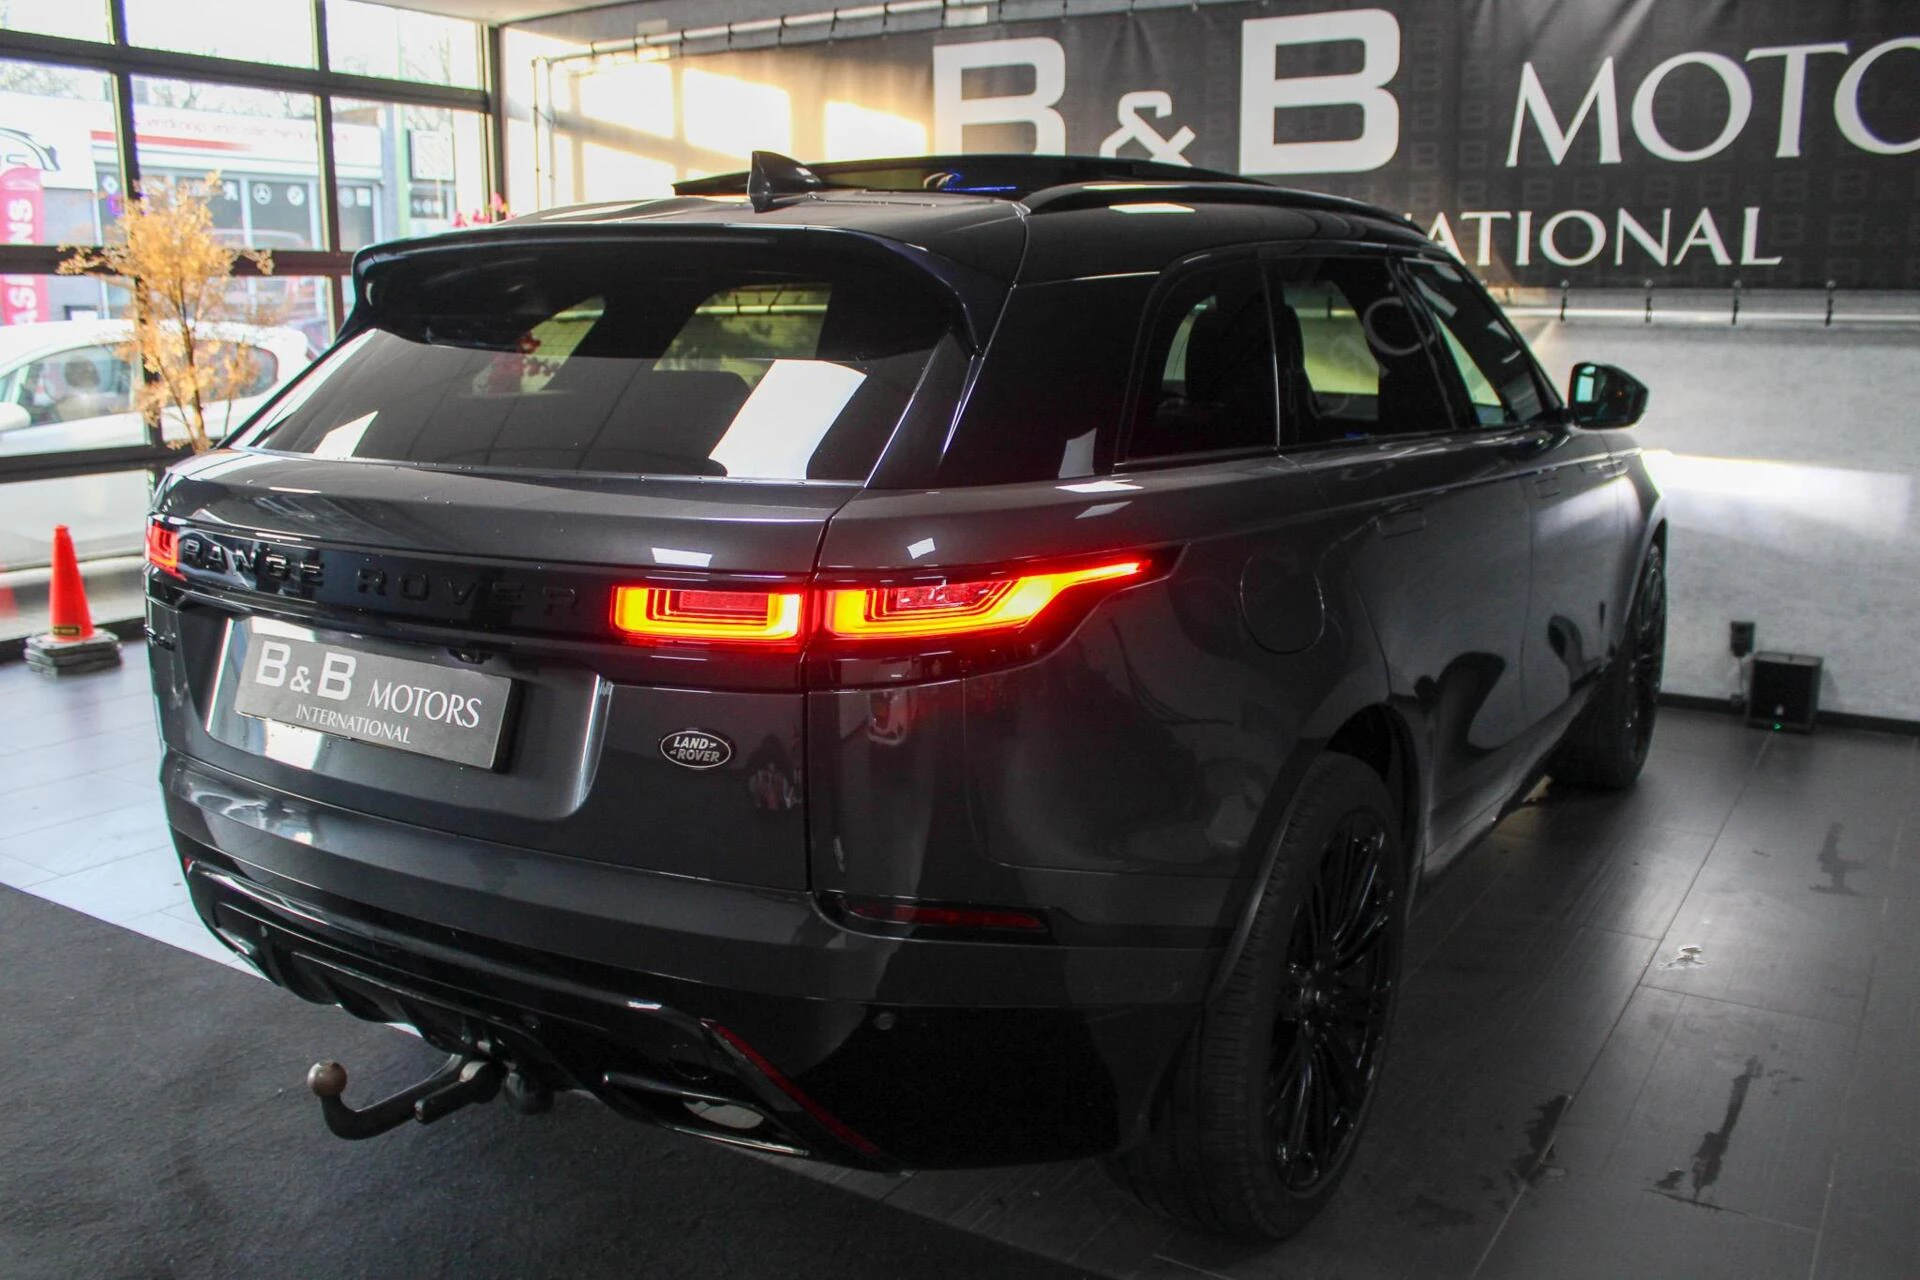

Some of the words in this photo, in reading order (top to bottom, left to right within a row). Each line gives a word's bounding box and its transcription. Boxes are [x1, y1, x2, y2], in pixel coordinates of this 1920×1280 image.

[1404, 206, 1783, 267] ATIONAL
[183, 538, 325, 587] RANGE
[356, 566, 582, 618] ROVER
[295, 704, 412, 745] INTERNATIONAL
[367, 679, 482, 729] MOTORS
[673, 736, 709, 750] LAND
[676, 748, 721, 762] ROVER
